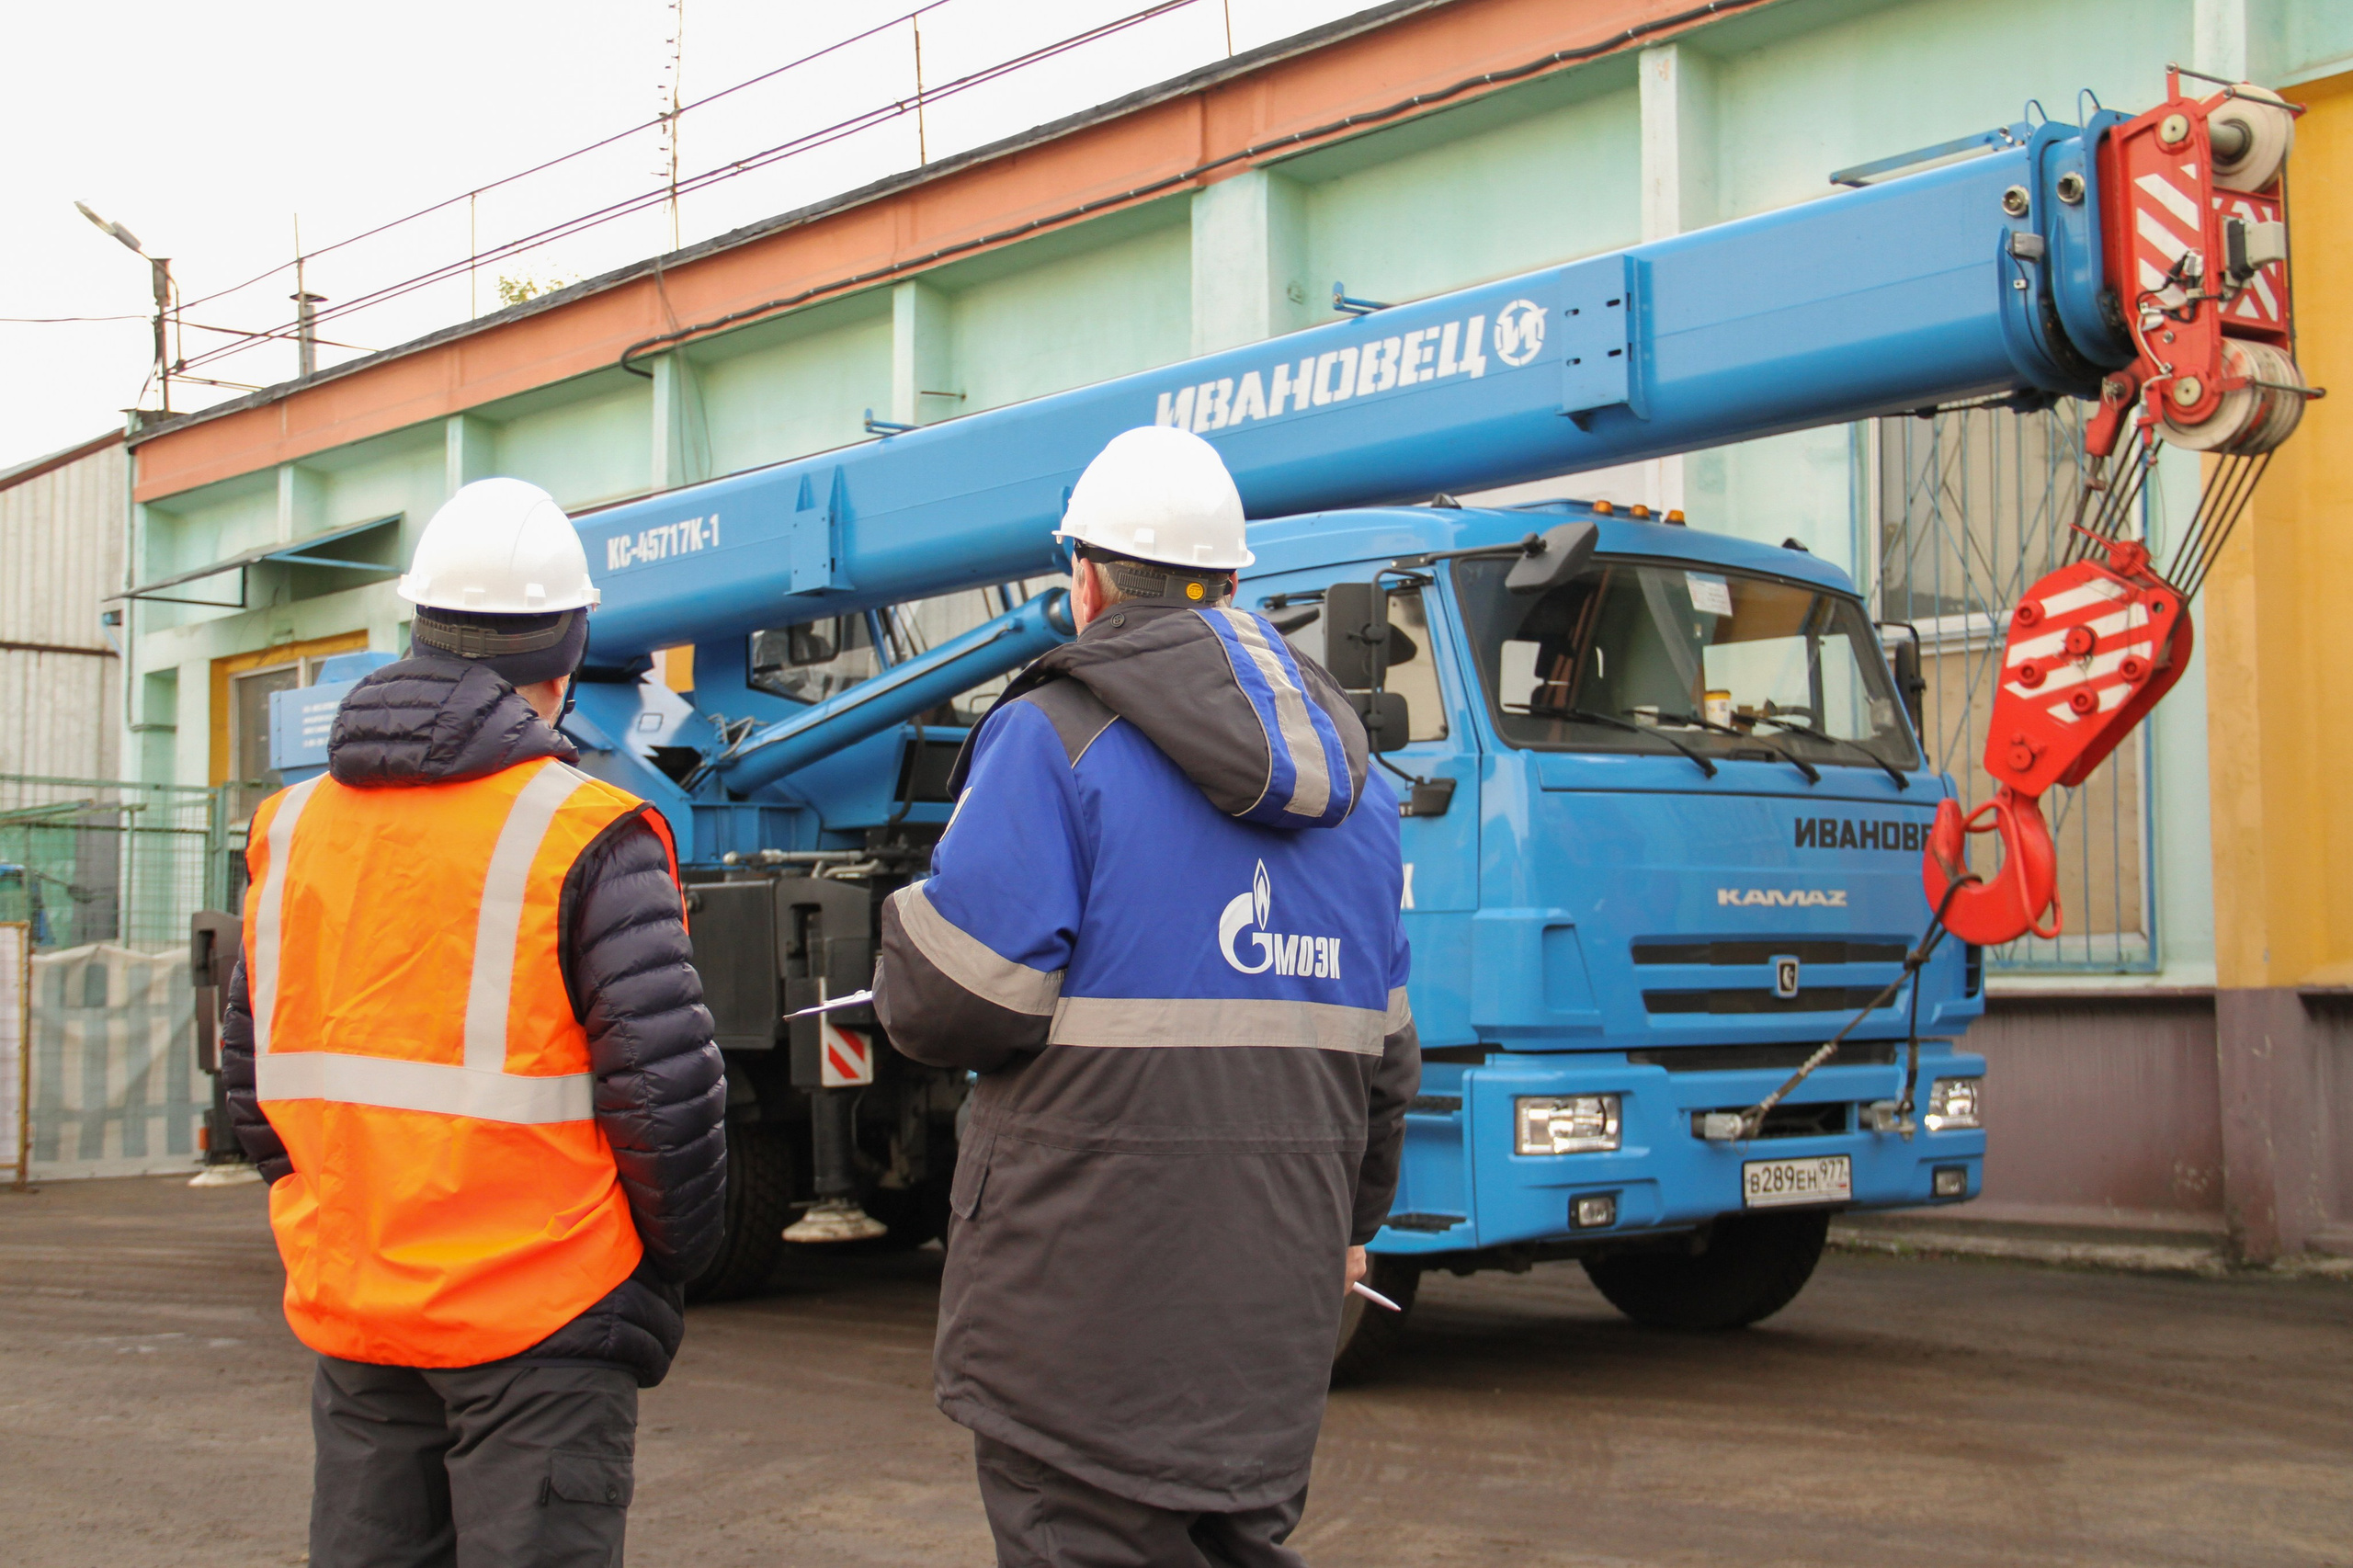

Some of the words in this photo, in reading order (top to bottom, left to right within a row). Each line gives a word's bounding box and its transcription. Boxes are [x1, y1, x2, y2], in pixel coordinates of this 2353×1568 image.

[1155, 314, 1486, 435] ИВАНОВЕЦ
[607, 513, 719, 570] КС-45717К-1
[1794, 817, 1934, 851] ИВАНОВЕ
[1717, 888, 1847, 906] KAMAZ
